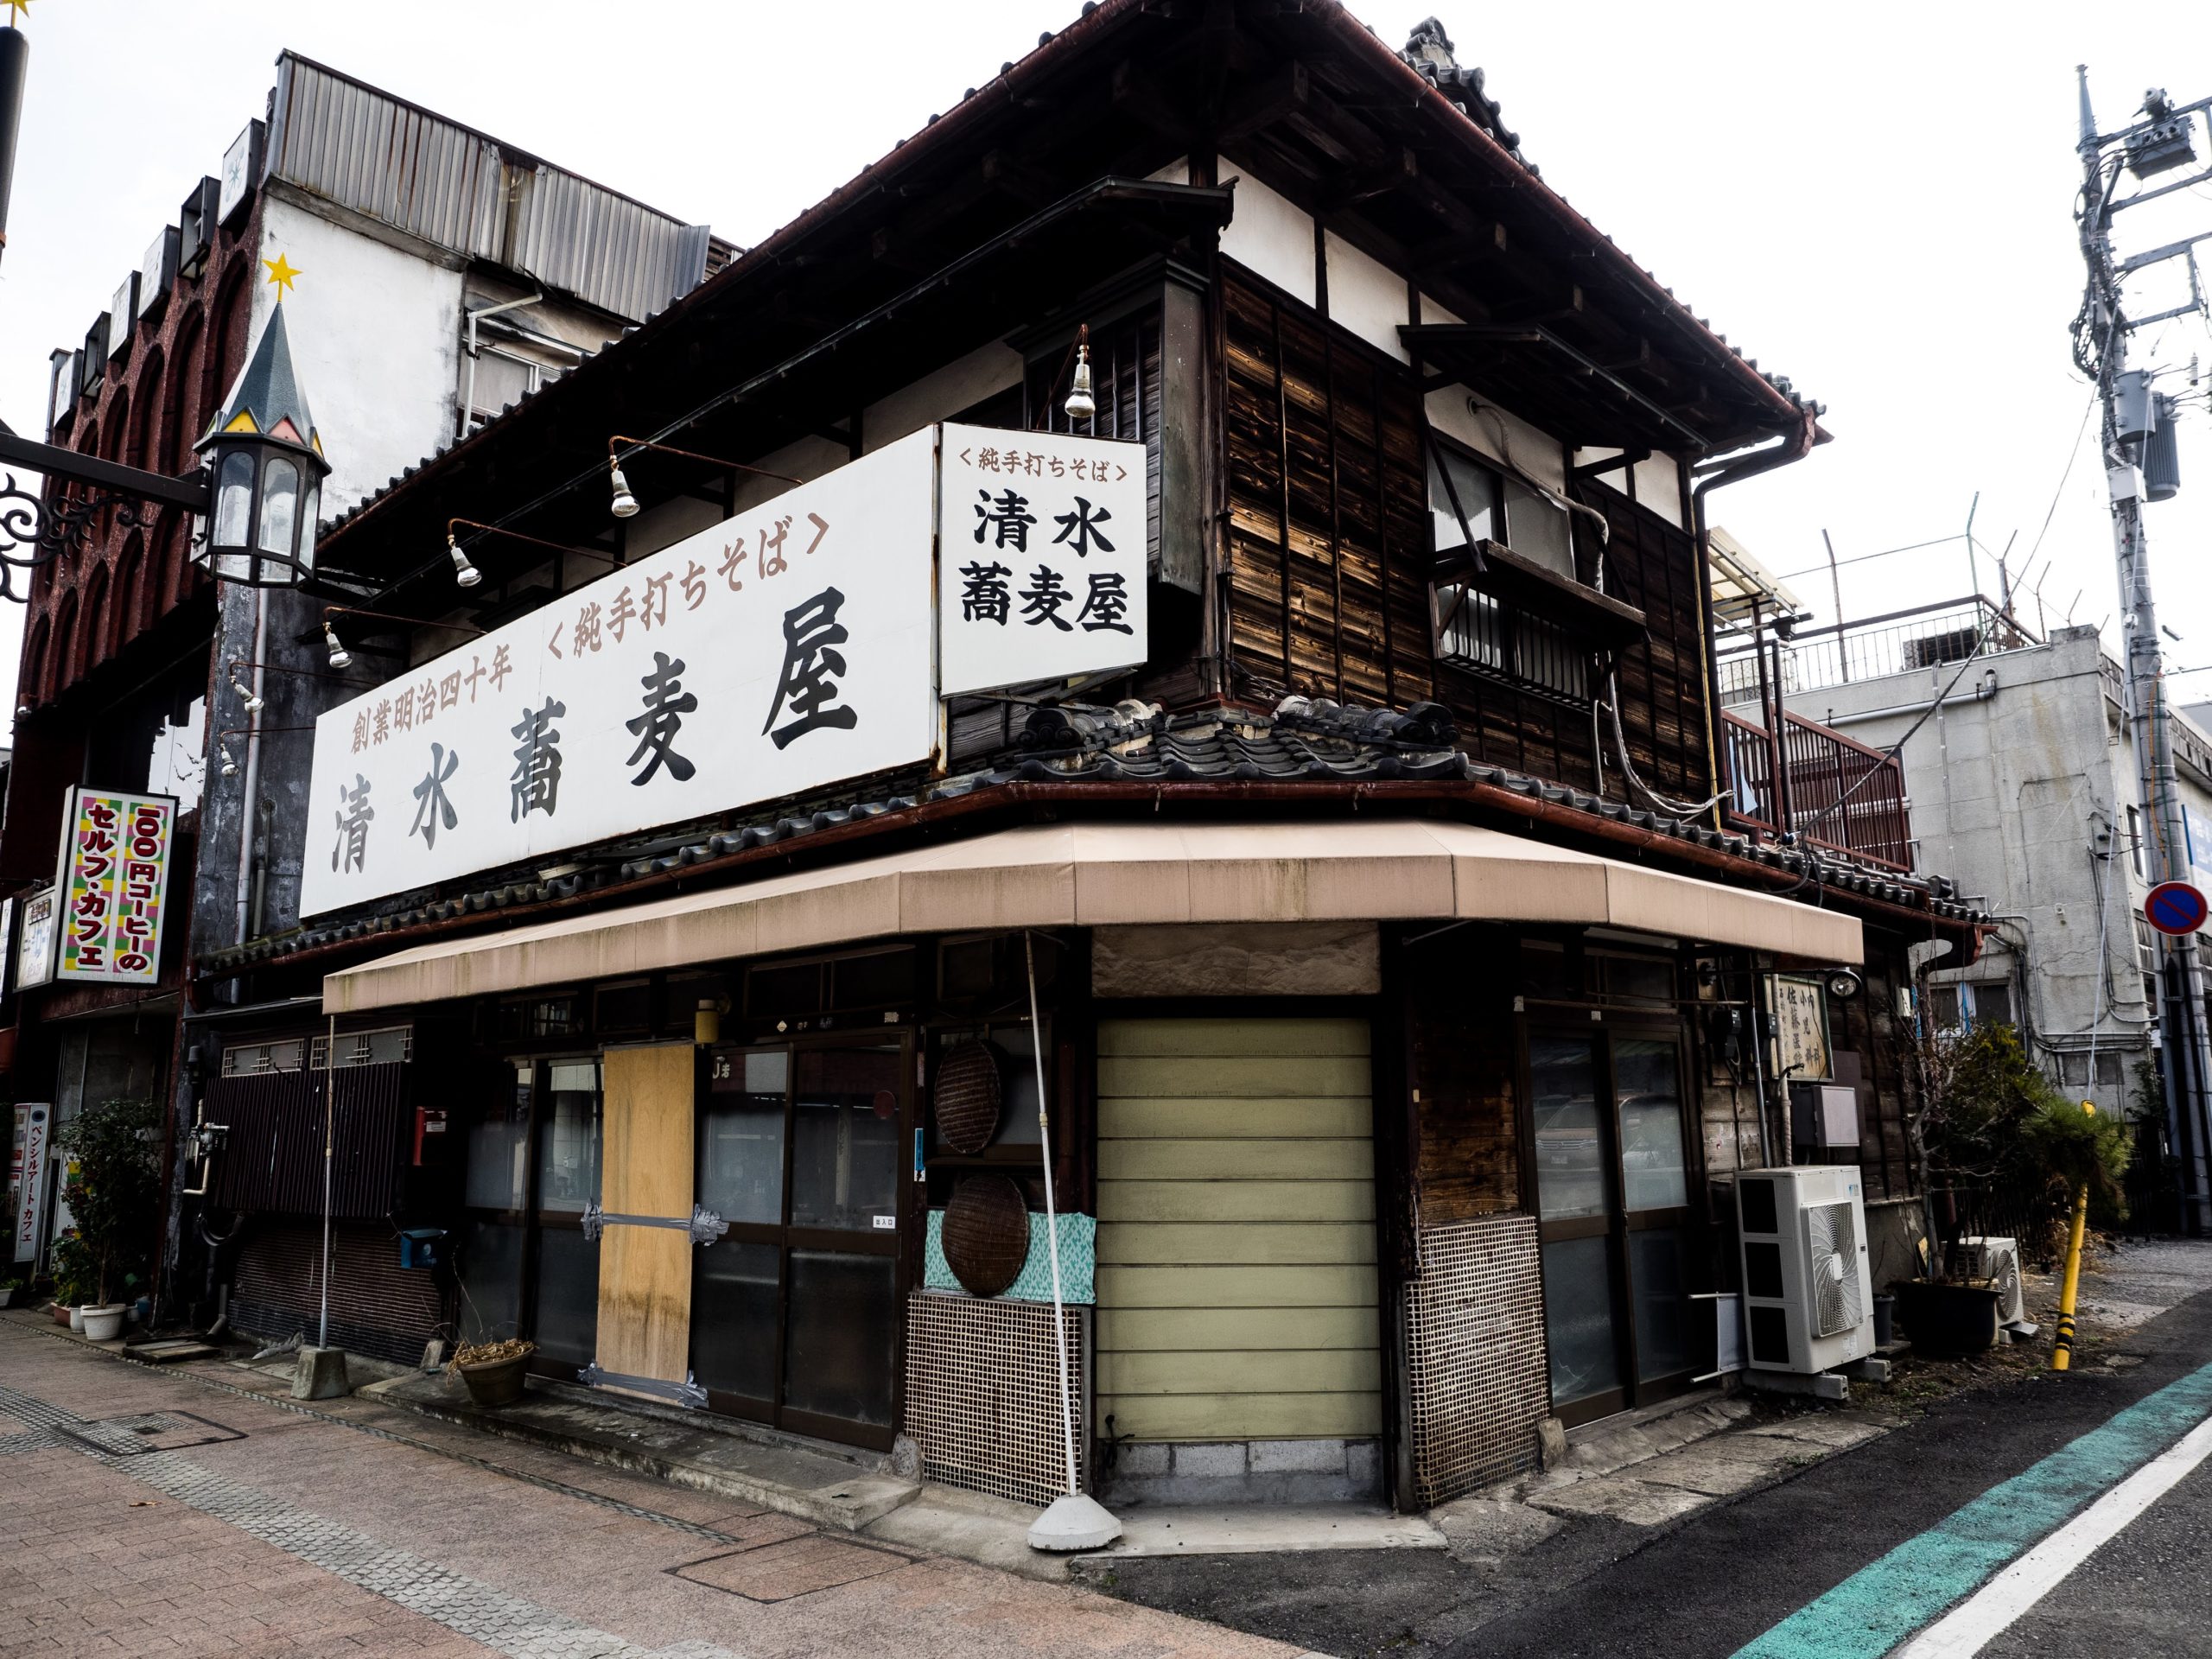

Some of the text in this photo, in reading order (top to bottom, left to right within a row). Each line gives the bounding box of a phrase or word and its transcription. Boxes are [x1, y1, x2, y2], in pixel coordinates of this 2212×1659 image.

[973, 488, 1116, 558] 清水
[958, 560, 1135, 636] 蕎麦屋
[350, 643, 513, 755] 創業明治四十年
